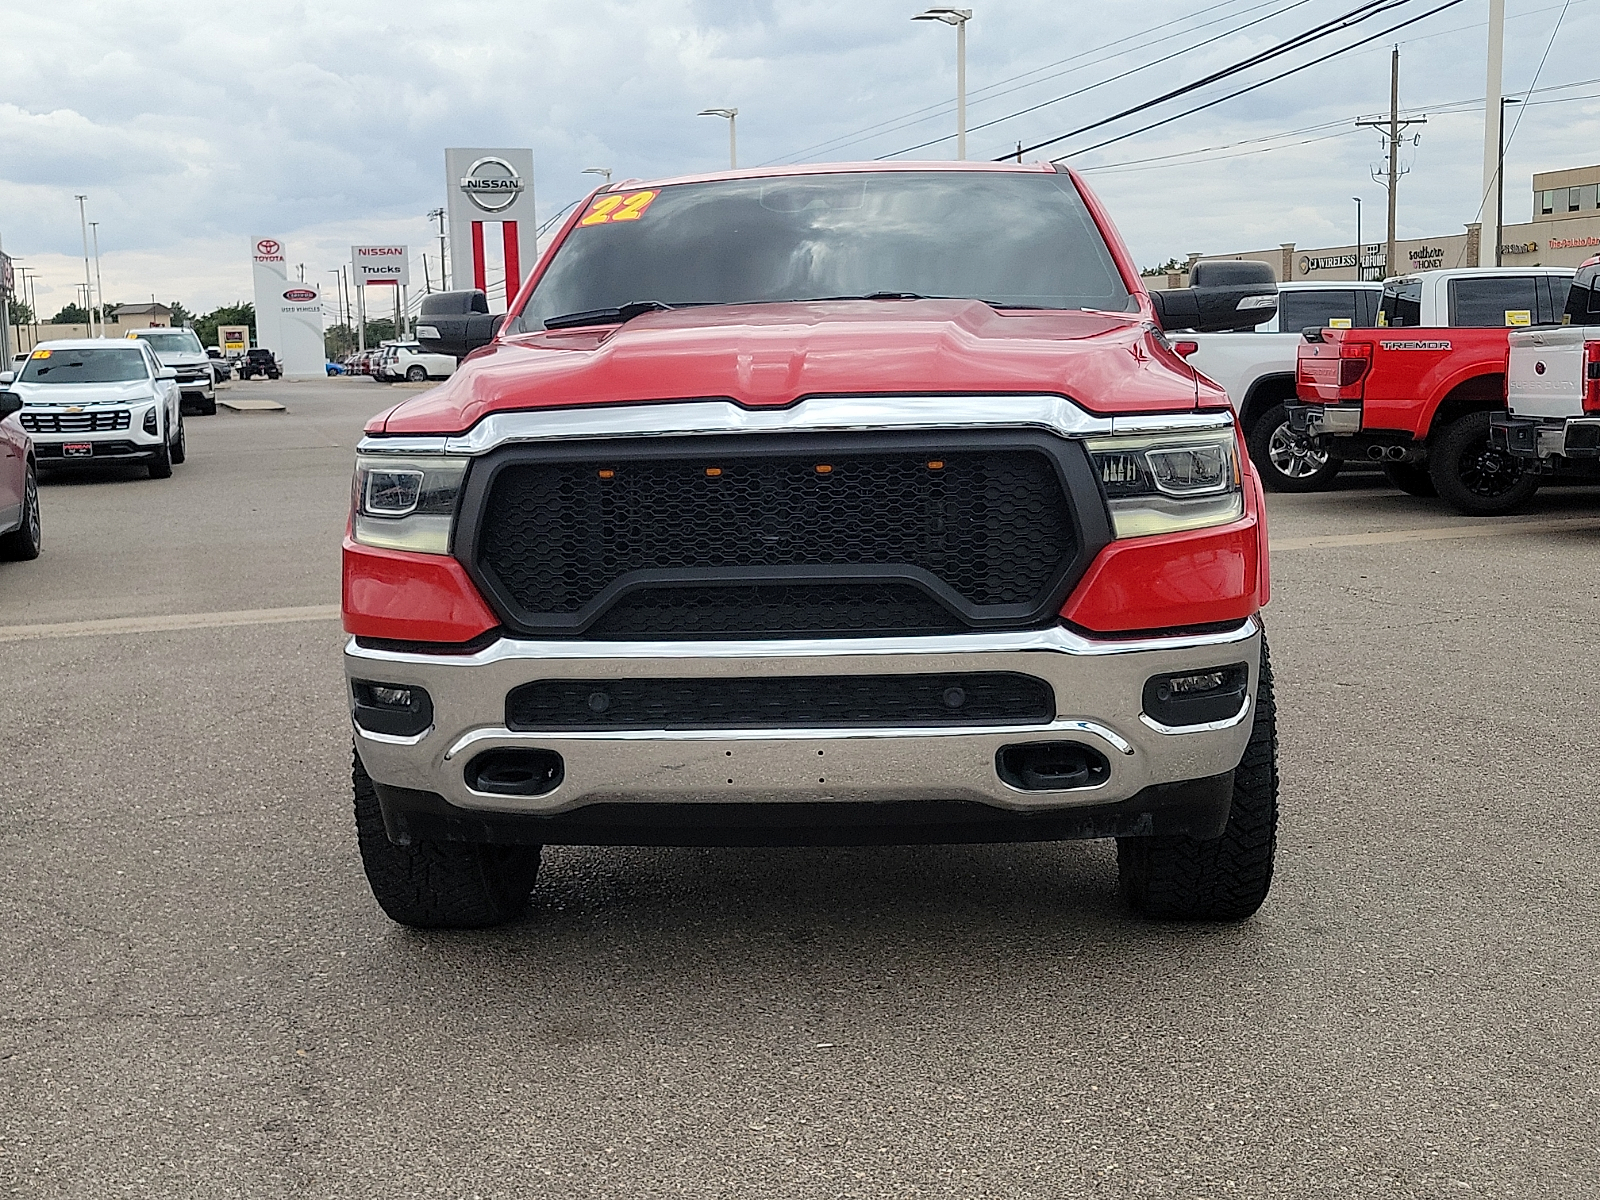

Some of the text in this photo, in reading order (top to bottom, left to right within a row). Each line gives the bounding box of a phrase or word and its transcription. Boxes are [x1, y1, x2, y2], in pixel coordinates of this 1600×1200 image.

[467, 179, 519, 189] NISSAN
[581, 191, 656, 226] 22
[358, 248, 403, 256] NISSAN
[1409, 246, 1444, 260] southern
[253, 255, 285, 263] TOYOTA
[1308, 255, 1357, 270] CJ WIRELESS
[361, 265, 401, 274] Trucks
[1418, 259, 1443, 270] HONEY
[1380, 340, 1453, 350] TREMOR
[1510, 381, 1575, 390] SUPER DUTY
